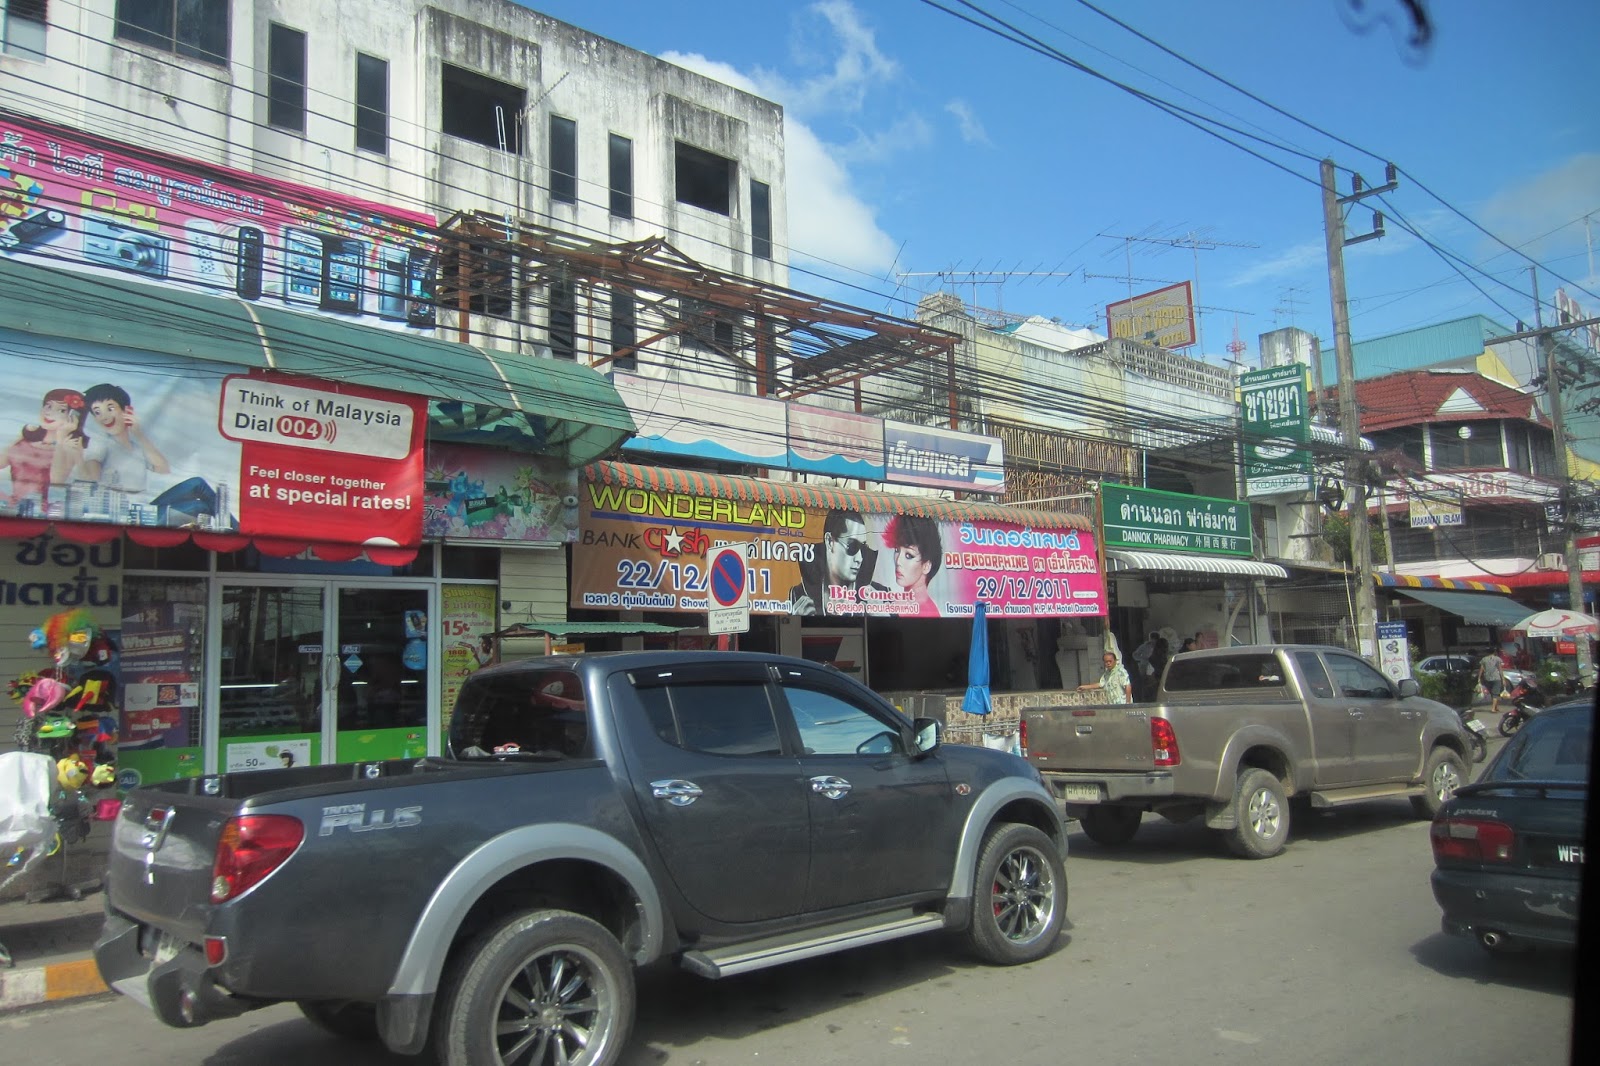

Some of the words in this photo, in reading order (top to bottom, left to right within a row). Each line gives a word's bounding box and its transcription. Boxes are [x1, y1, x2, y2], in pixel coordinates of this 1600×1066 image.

[238, 389, 284, 409] Think
[292, 400, 310, 413] of
[316, 398, 401, 427] Malaysia
[235, 412, 274, 433] Dial
[279, 417, 319, 438] 004
[249, 465, 279, 479] Feel
[284, 470, 326, 484] closer
[330, 475, 386, 491] together
[249, 484, 270, 499] at
[276, 487, 347, 506] special
[352, 494, 412, 510] rates!
[588, 483, 806, 529] WONDERLAND
[1120, 495, 1182, 526] ด่านนอก
[582, 530, 643, 549] BANK
[776, 528, 804, 538] Club
[1122, 530, 1152, 544] DANNOK
[1153, 533, 1189, 547] PHARMACY
[761, 540, 815, 563] แคลช
[945, 553, 961, 567] DA
[964, 553, 1028, 569] ENDORPHINE
[0, 566, 119, 606] เตชั่น
[617, 558, 771, 595] 22/12/11
[977, 575, 1070, 598] 29/12/2011
[585, 594, 608, 604] เวลา
[611, 595, 619, 604] 3
[829, 585, 856, 601] Big
[858, 586, 915, 601] Concert
[827, 603, 833, 611] 2
[946, 603, 973, 613] โรงแรม
[1034, 604, 1055, 613] K.P.K.
[1056, 603, 1074, 613] Hotel
[1075, 603, 1099, 613] Dannok
[245, 758, 258, 767] 50
[318, 805, 423, 837] PLUS
